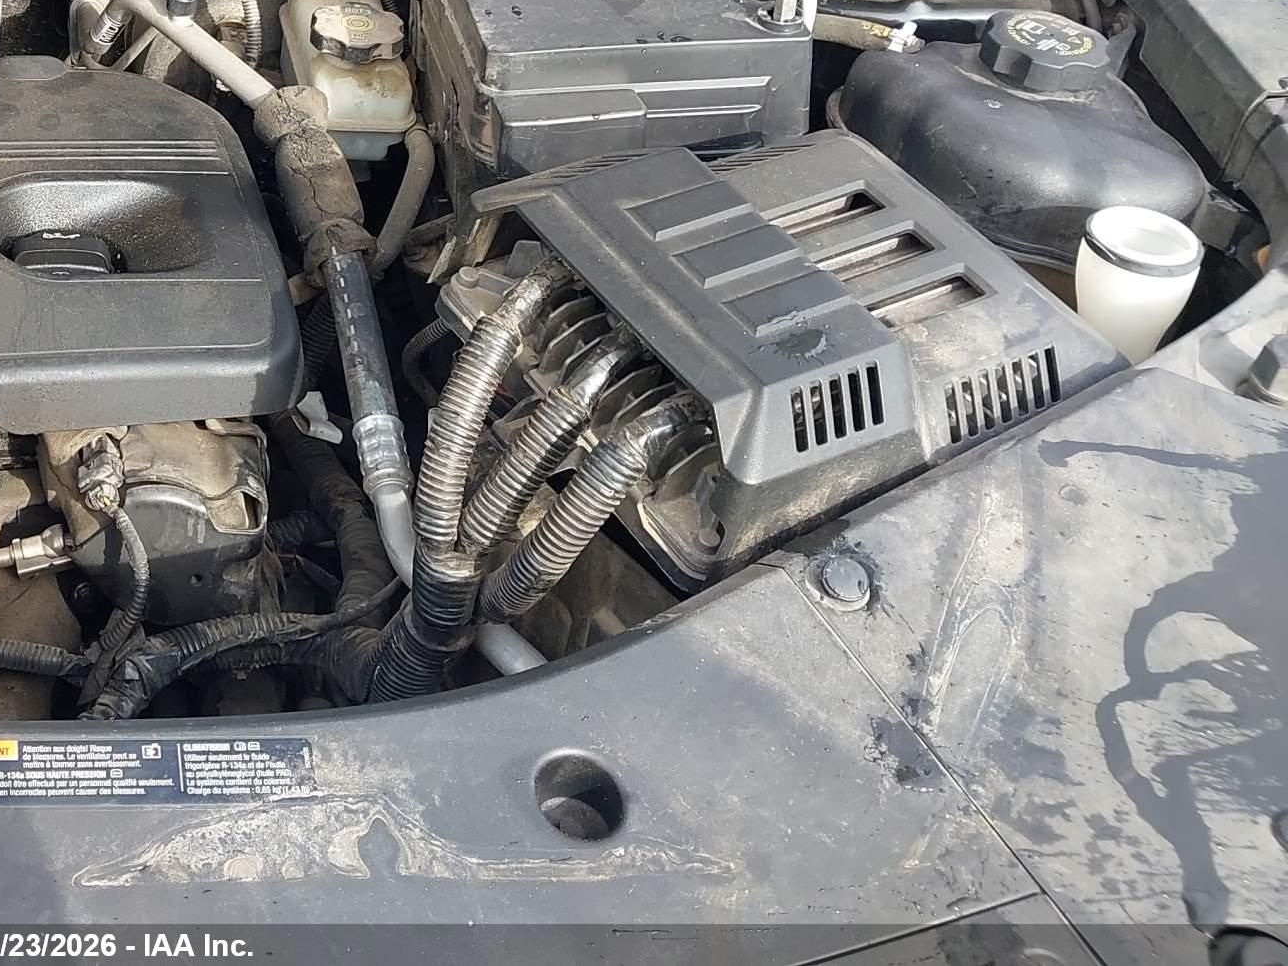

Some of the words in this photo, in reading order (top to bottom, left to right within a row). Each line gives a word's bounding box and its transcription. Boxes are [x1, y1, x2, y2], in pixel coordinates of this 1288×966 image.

[23, 753, 31, 761] de
[197, 778, 224, 787] système
[222, 787, 250, 795] système
